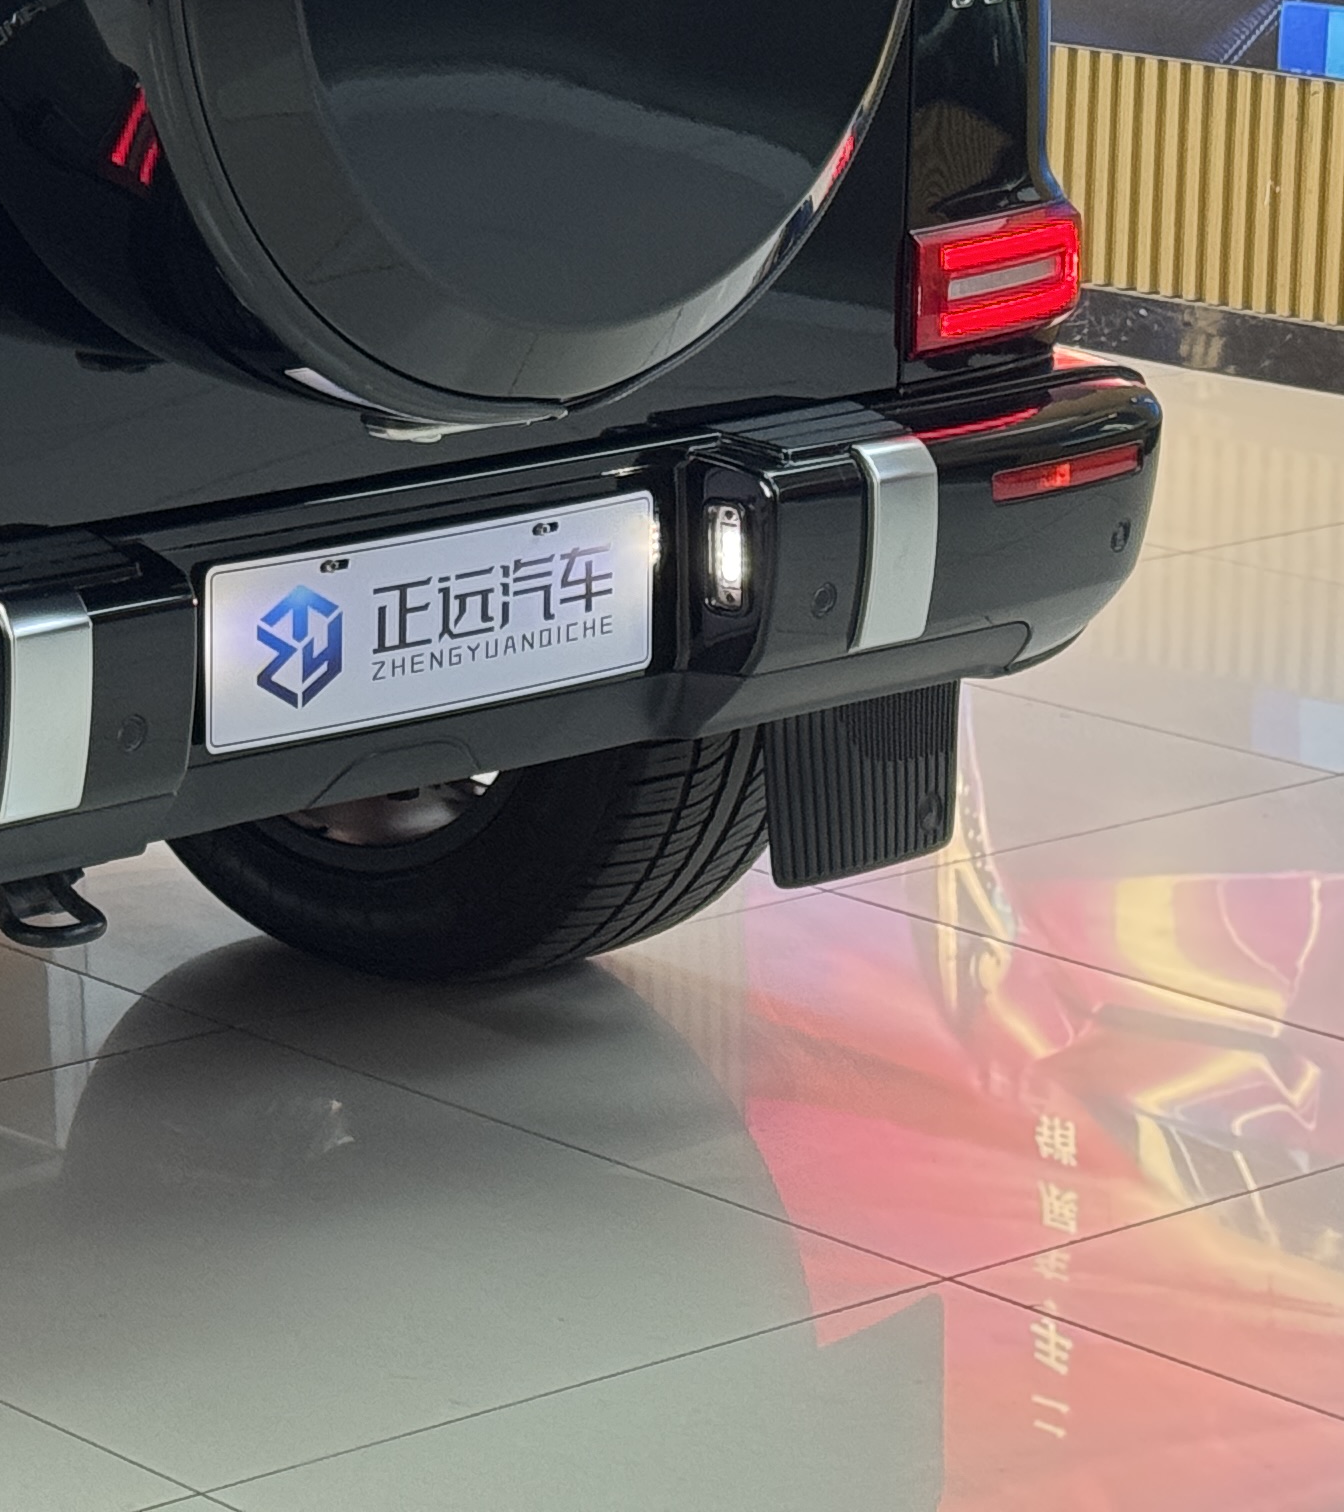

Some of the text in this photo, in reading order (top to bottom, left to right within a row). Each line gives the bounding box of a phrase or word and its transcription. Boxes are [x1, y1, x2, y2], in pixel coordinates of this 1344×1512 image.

[372, 543, 613, 655] 正远汽车
[371, 615, 613, 681] ZHENGYUANQICHE
